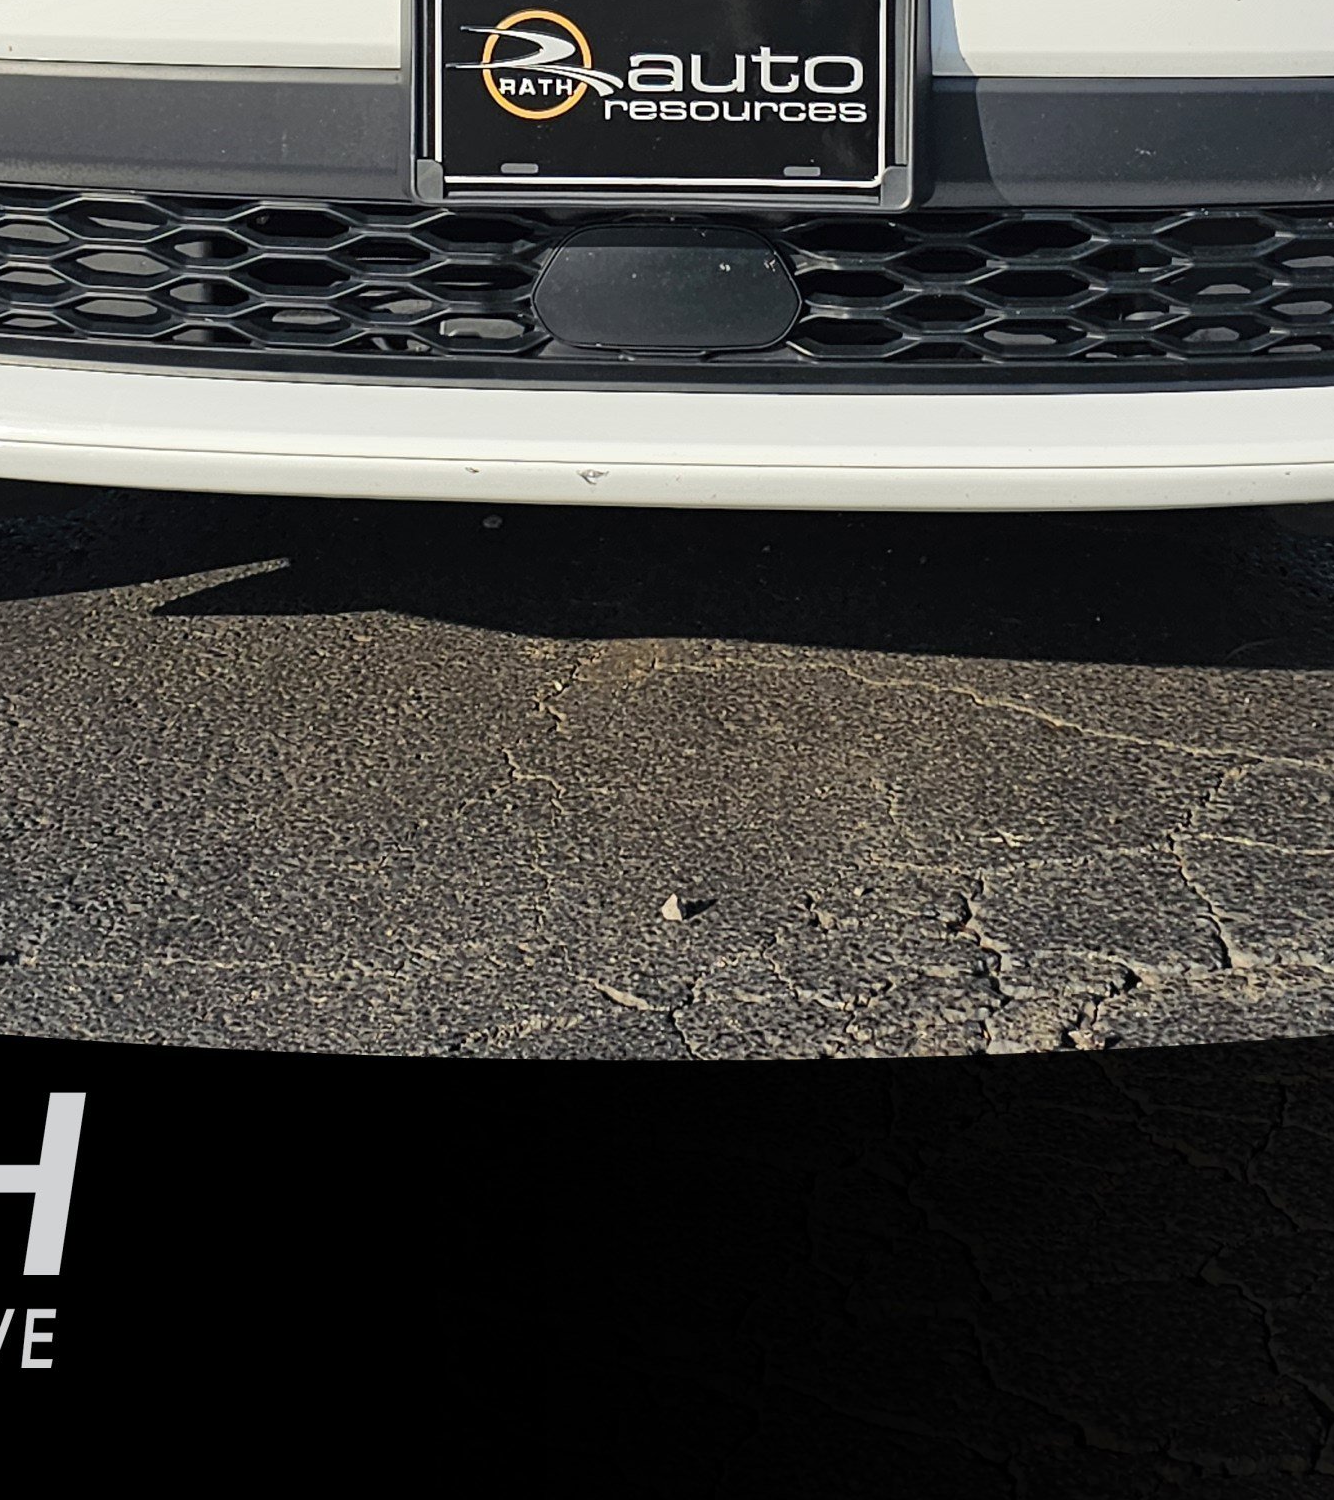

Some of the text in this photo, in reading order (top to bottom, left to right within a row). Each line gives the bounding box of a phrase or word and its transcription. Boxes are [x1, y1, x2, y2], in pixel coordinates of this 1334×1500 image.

[628, 46, 864, 94] auto
[498, 77, 576, 97] RATH
[603, 99, 868, 123] resources
